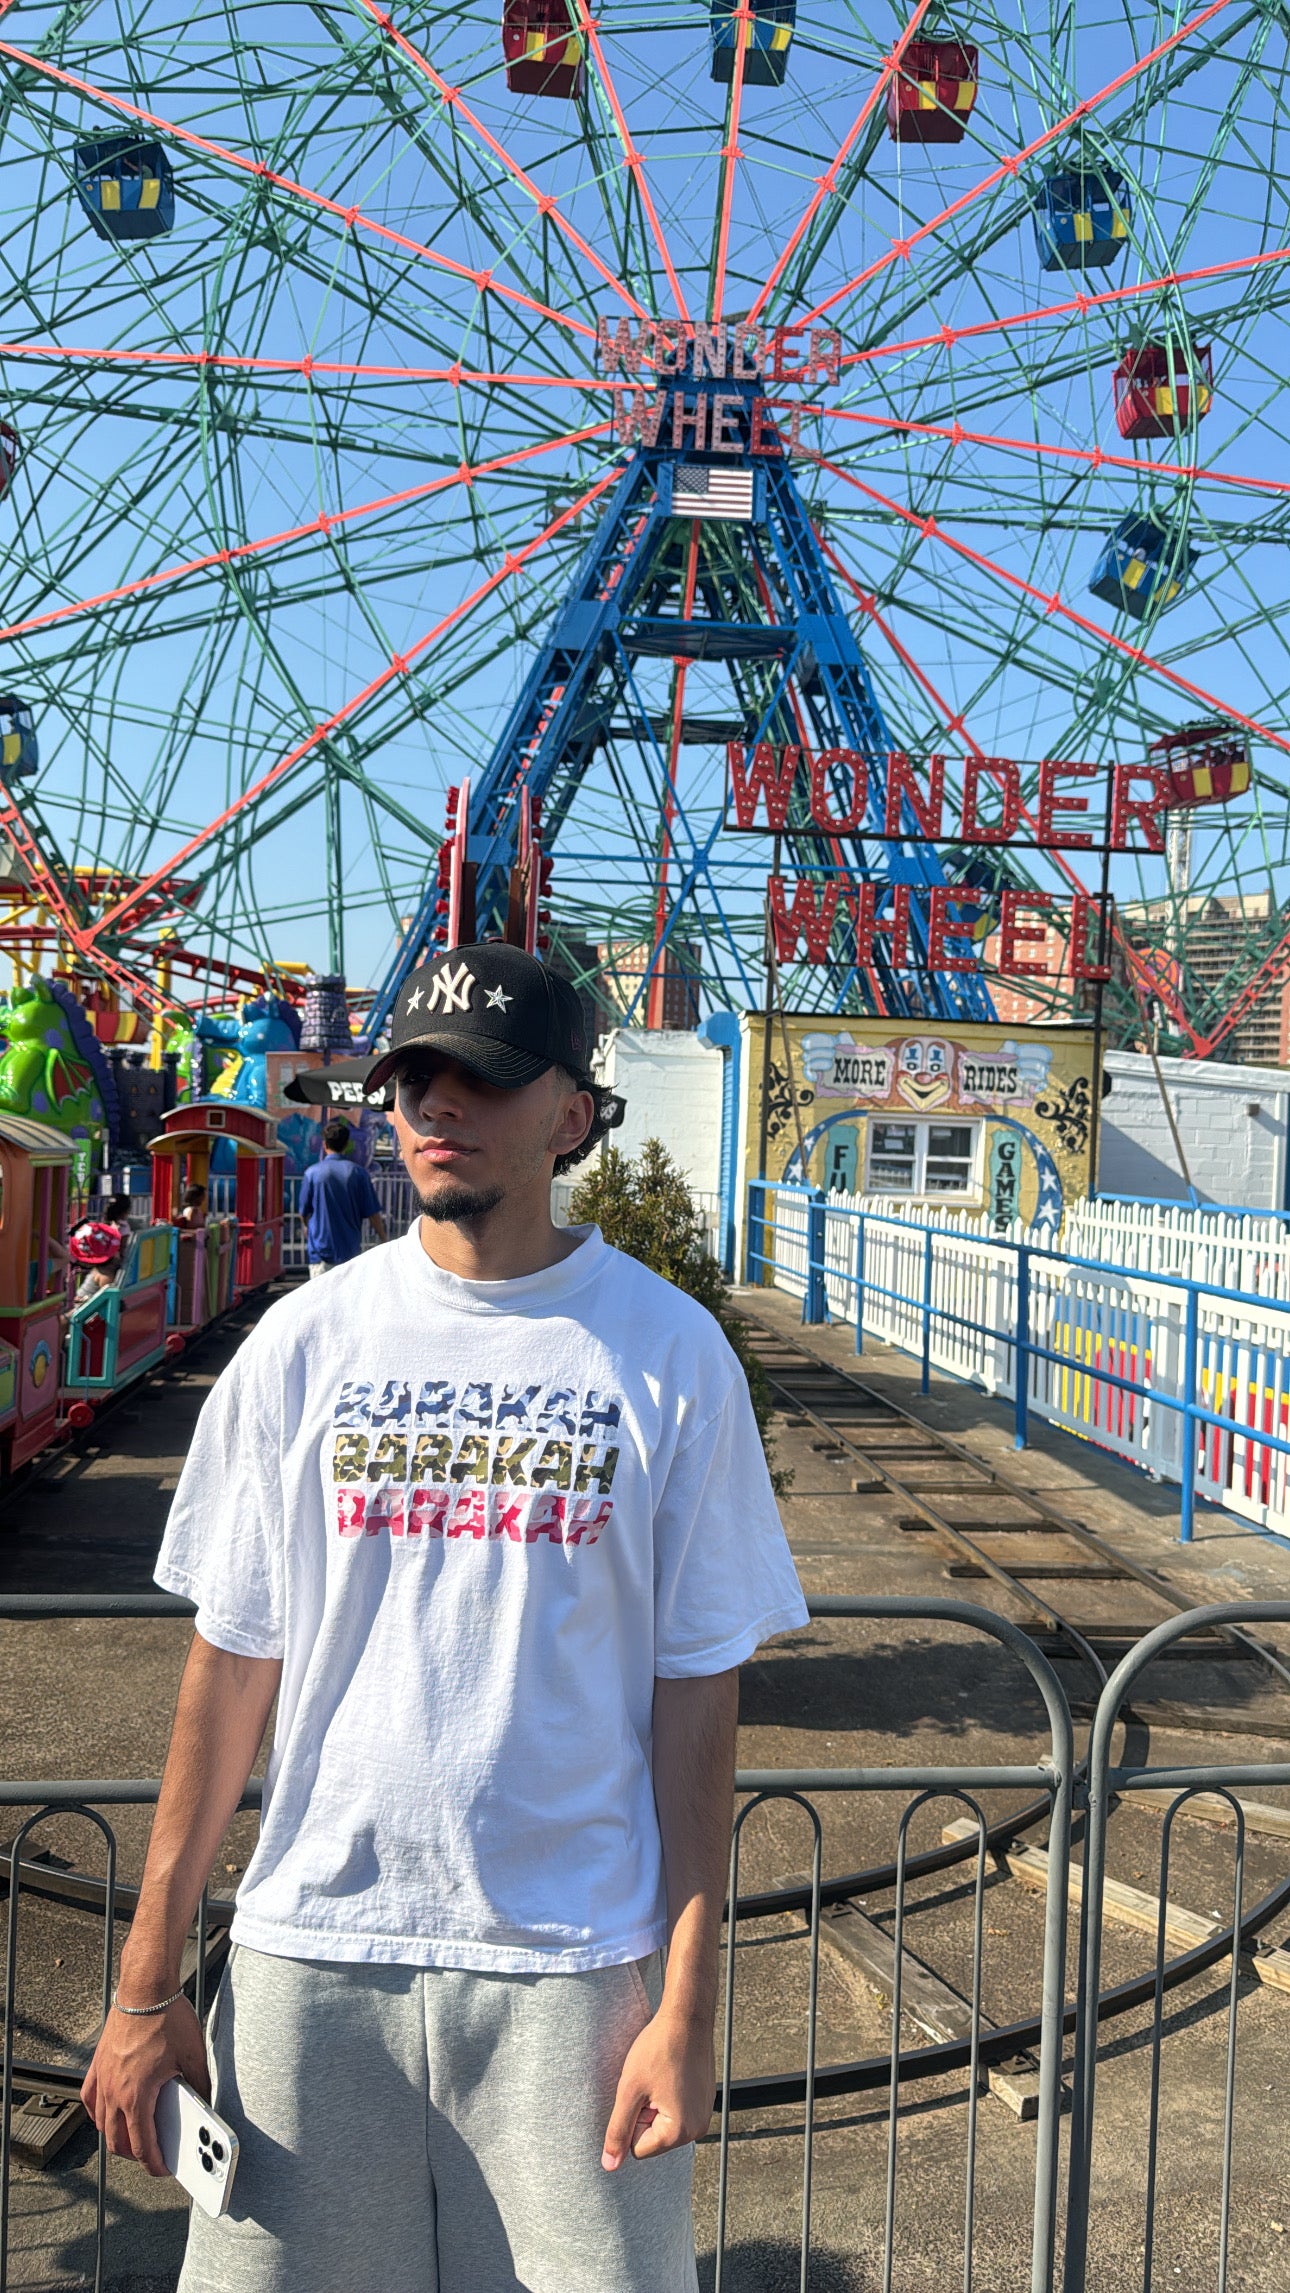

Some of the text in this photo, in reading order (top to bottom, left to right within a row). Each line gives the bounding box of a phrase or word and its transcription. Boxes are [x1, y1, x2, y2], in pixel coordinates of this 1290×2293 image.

[597, 315, 842, 385] WONDER
[613, 388, 822, 459] WHEEL
[726, 741, 1170, 852] WONDER
[768, 876, 1112, 980] WHEEL
[426, 962, 476, 1014] NY
[833, 1057, 1018, 1093] MORE RIDES
[996, 1142, 1016, 1233] GAMES
[332, 1380, 622, 1440] BARAKAH
[333, 1433, 620, 1494] BARAKAH
[337, 1488, 613, 1546] BARAKAH
